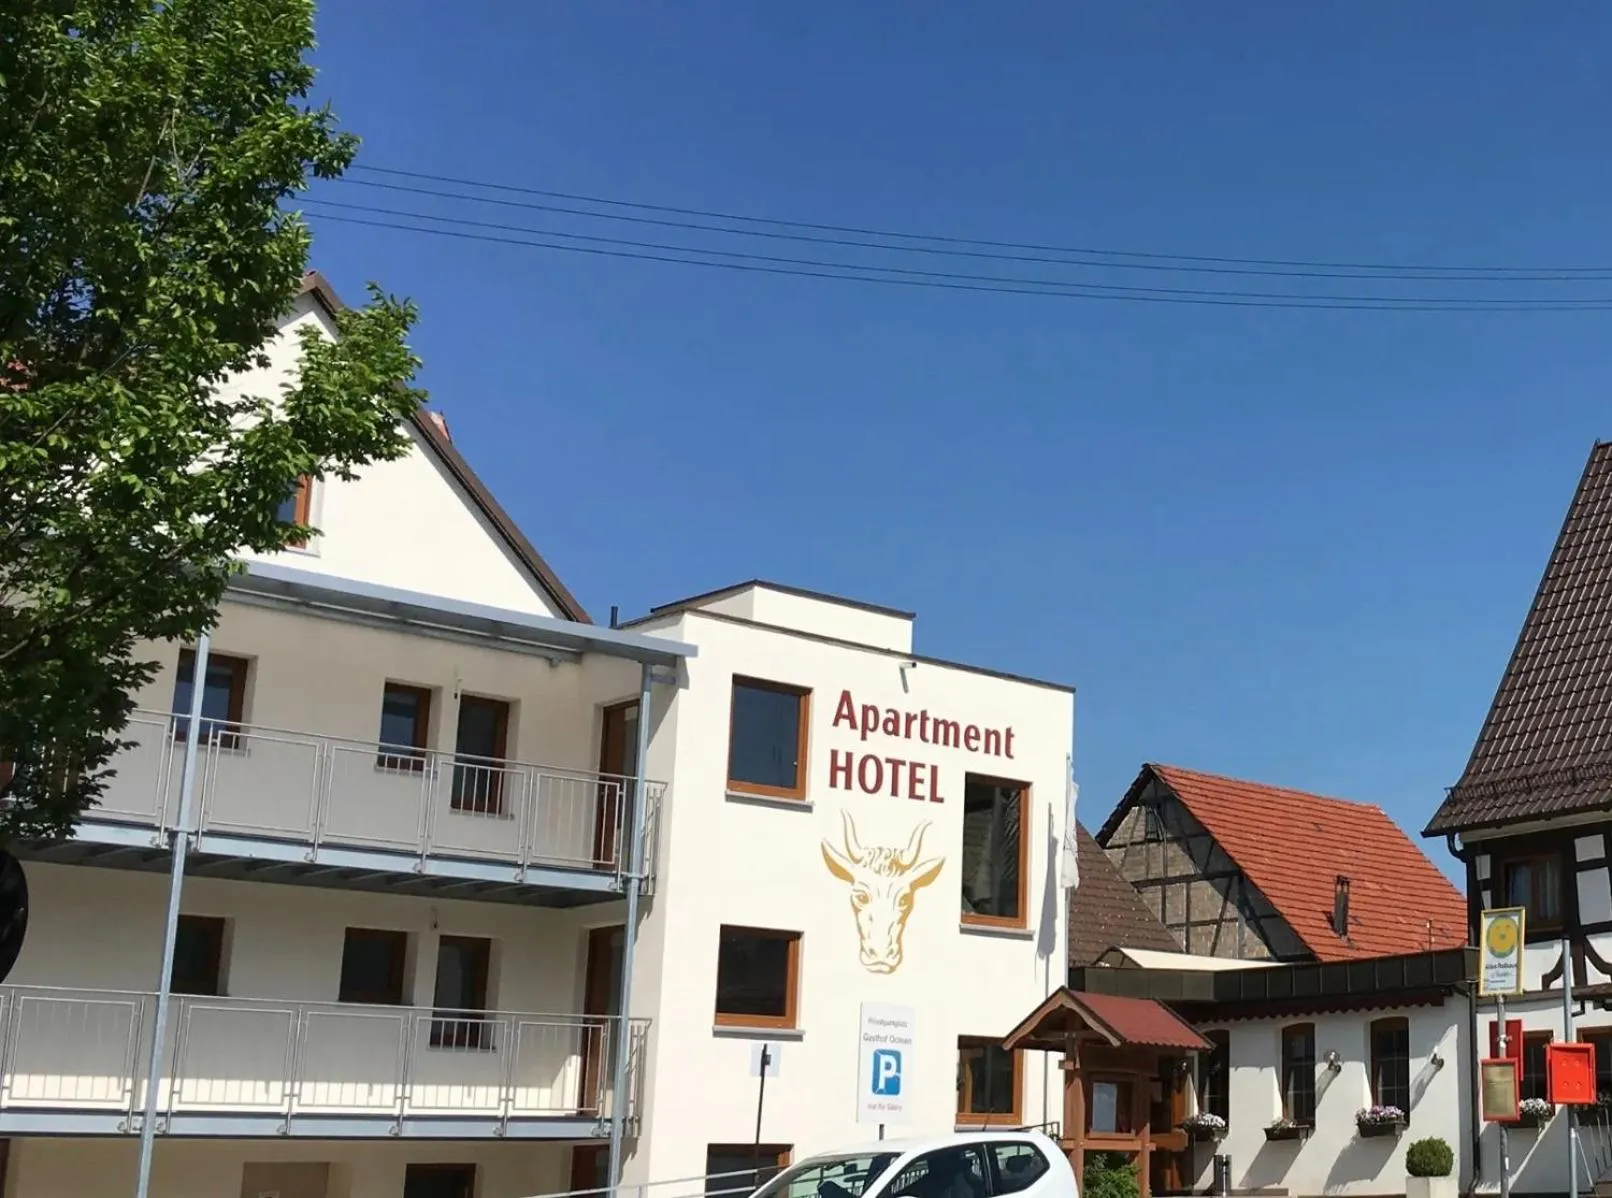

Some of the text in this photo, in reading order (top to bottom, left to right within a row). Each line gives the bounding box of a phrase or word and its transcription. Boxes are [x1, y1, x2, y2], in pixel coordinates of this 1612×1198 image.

[832, 690, 1016, 759] Apartment
[828, 749, 945, 804] HOTEL
[878, 1054, 897, 1089] P
